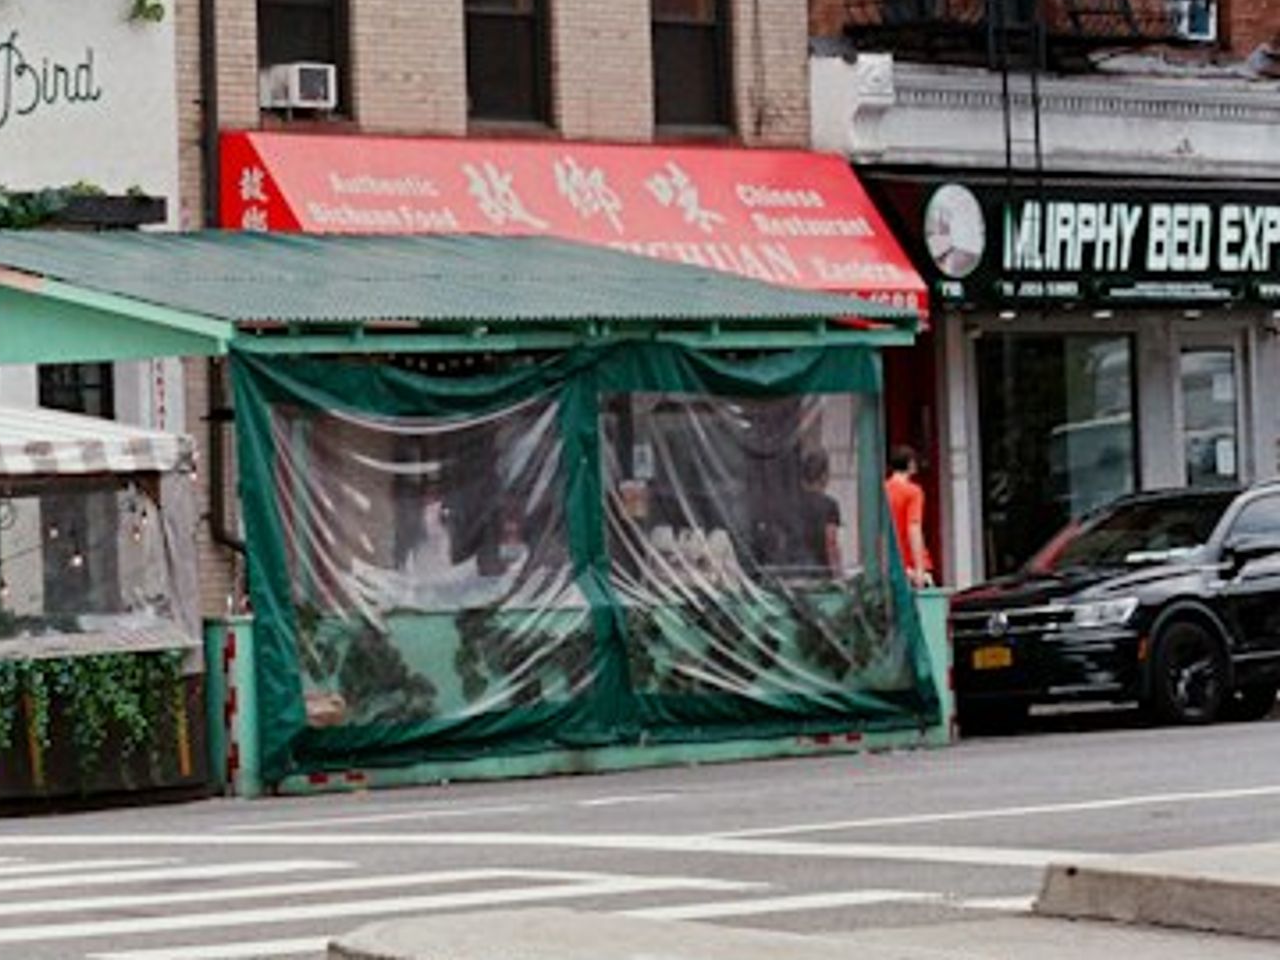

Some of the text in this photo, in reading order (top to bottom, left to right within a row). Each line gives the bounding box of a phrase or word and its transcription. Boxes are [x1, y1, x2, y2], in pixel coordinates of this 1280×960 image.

[736, 184, 826, 208] Chinese
[751, 213, 876, 236] Restaurant
[1002, 200, 1142, 272] MURPHY
[1146, 203, 1212, 272] BED
